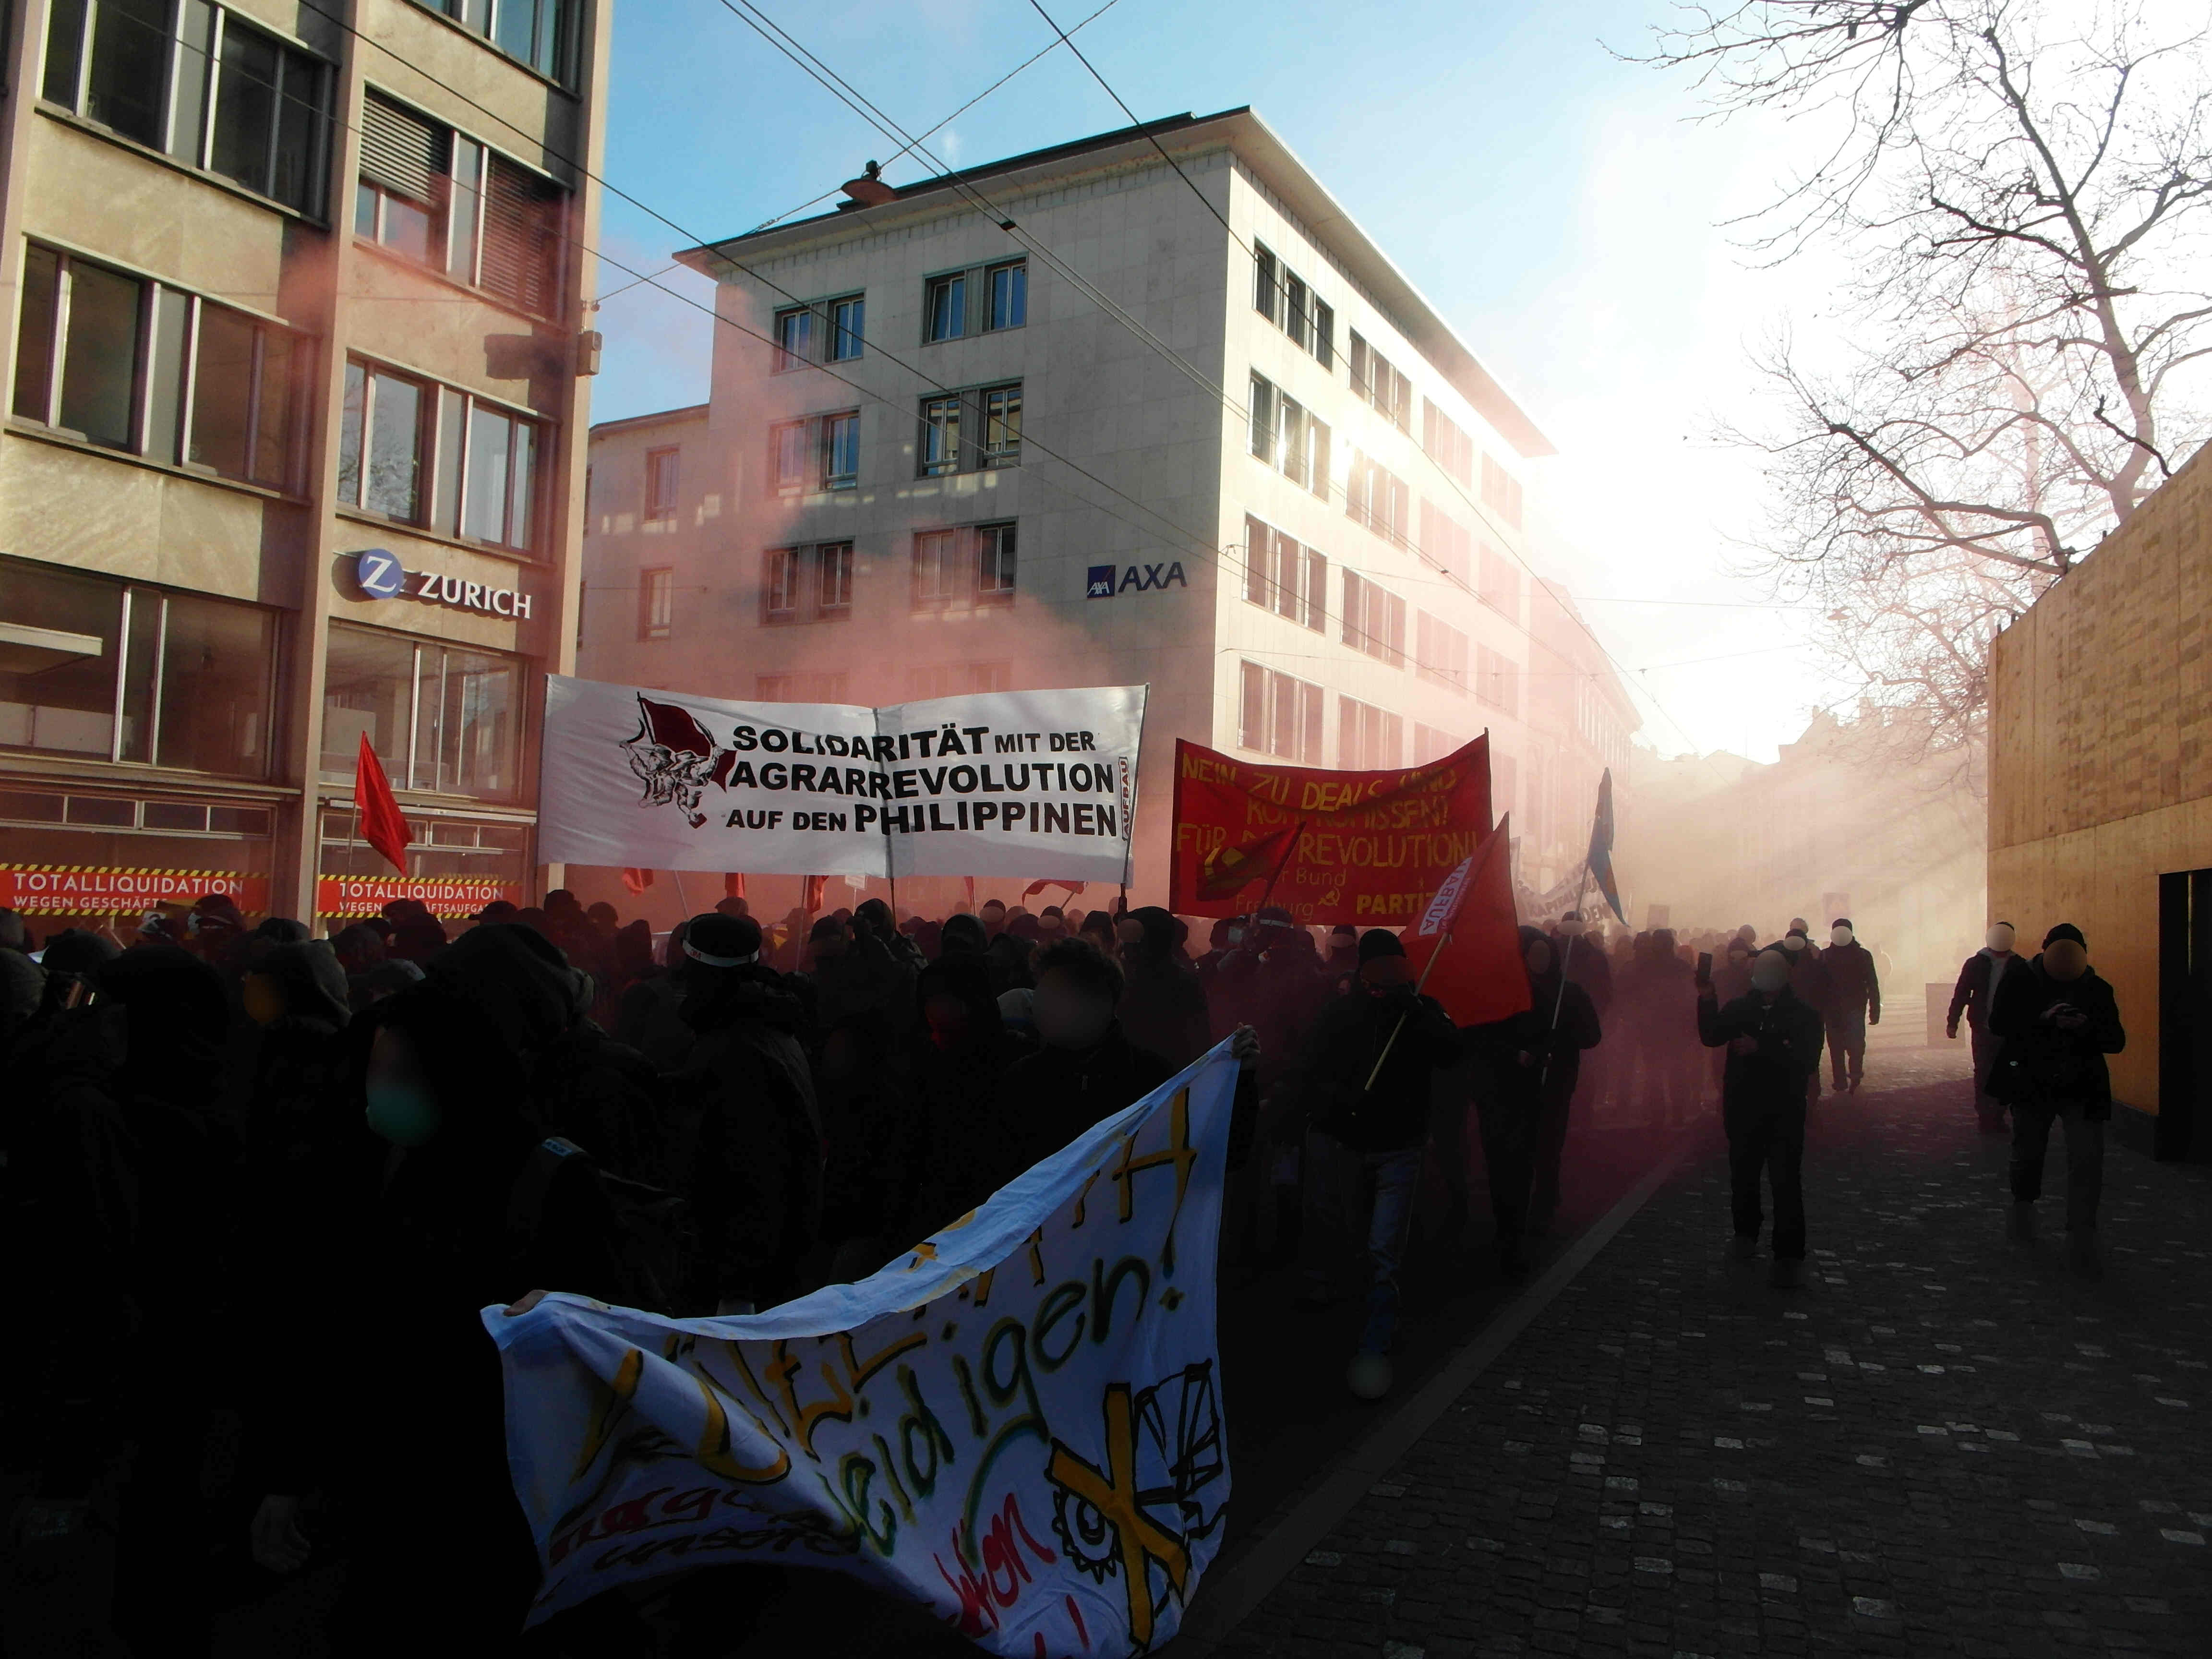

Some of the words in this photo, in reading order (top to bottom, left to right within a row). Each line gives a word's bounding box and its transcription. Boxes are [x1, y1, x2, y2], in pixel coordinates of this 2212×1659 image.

[1087, 581, 1110, 596] AXA
[1118, 562, 1188, 593] AXA
[417, 571, 531, 619] ZURICH
[733, 722, 989, 763] SOLIDARITÄT
[995, 733, 1041, 753] MIT
[1049, 731, 1096, 752] DER
[729, 761, 1114, 800] AGRARREVOLUTION
[1181, 752, 1237, 786] NEIN
[1248, 771, 1291, 805] ZU
[725, 809, 783, 830] AUF
[793, 812, 846, 831] DEN
[854, 801, 1117, 837] PHILIPPINEN
[1176, 822, 1227, 855] FÜR
[14, 873, 243, 895] TOTALLIQUIDATION
[339, 882, 504, 900] TOTALLIQUIDATION
[1296, 866, 1346, 887] Bund
[13, 896, 73, 908] WEGEN
[80, 895, 168, 909] GESCHÄFT
[339, 902, 382, 912] WEGEN
